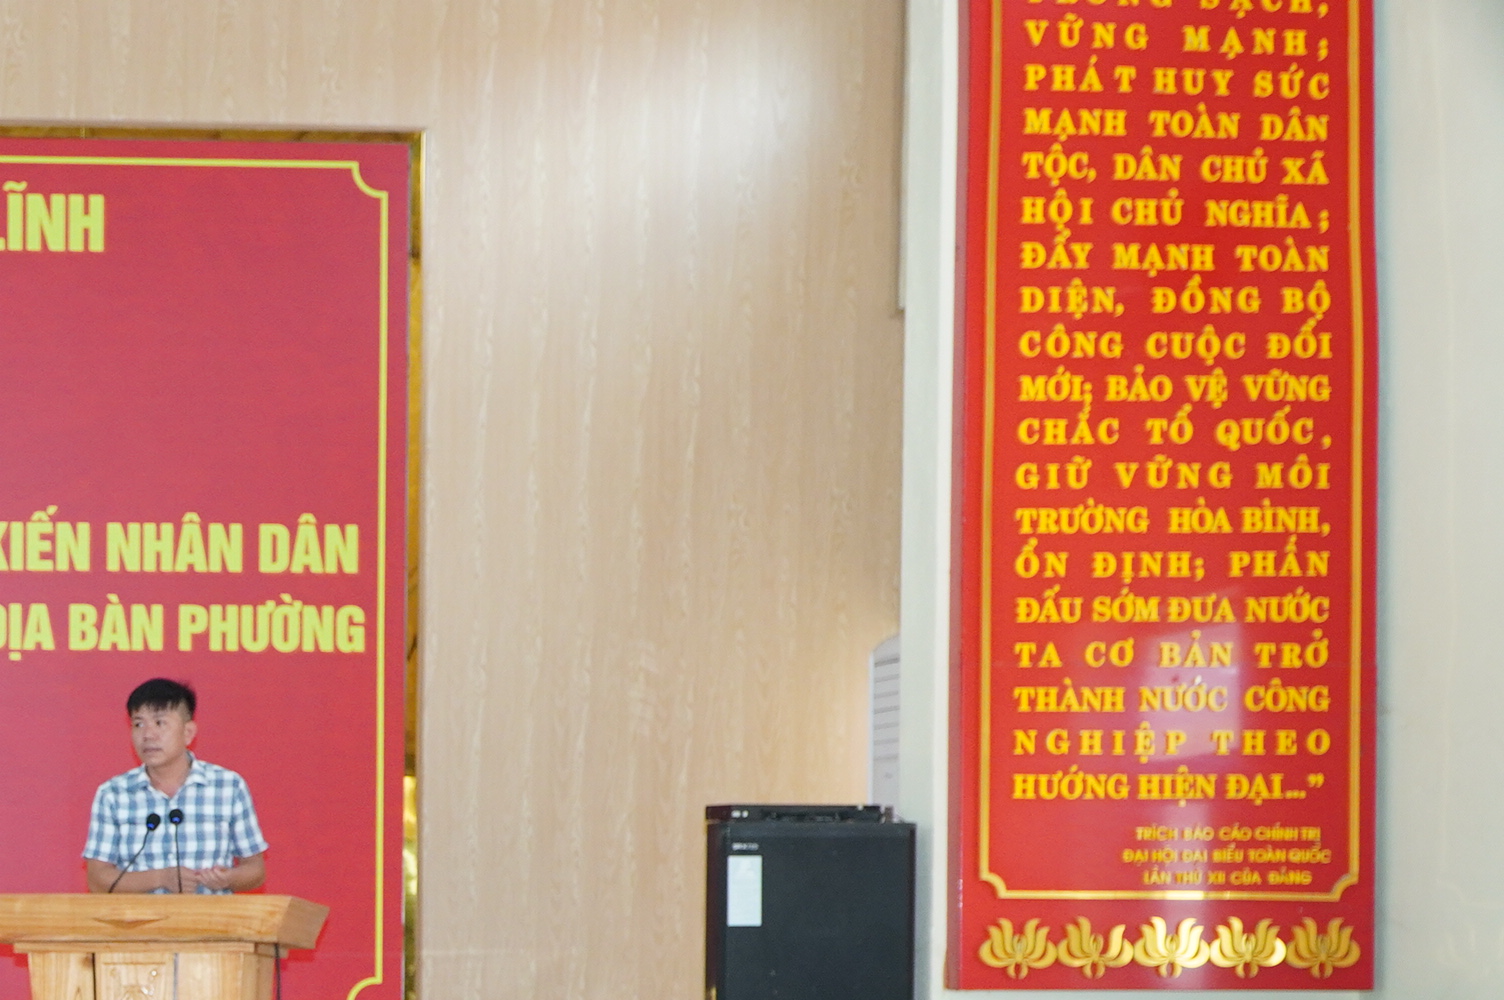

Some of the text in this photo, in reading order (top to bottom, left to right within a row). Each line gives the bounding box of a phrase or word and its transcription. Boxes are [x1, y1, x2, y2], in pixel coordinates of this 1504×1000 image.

[1025, 13, 1148, 49] VỮNG
[1025, 55, 1328, 99] PHÁT HUY SỨC
[1024, 104, 1328, 141] MẠNH TOÀN DÂN
[1022, 143, 1328, 186] TỘC, DÂN CHỦ XÃ
[1020, 188, 1093, 231] HỘI
[1112, 189, 1183, 225] CHỦ
[1113, 243, 1213, 276] MẠNH
[1236, 238, 1328, 271] TOÀN
[1021, 278, 1124, 319] DIỆN,
[1283, 280, 1330, 318] BỘ
[1019, 323, 1123, 357] CÔNG
[1146, 325, 1245, 365] CUỘC
[1106, 365, 1172, 401] BẢO
[1182, 368, 1227, 410] VỆ
[1243, 369, 1330, 401] VỮNG
[1015, 454, 1329, 489] GIỮ VỮNG MÔI
[1015, 497, 1330, 535] TRƯỜNG HÒA BÌNH,
[106, 512, 243, 573] NHÂN
[258, 513, 359, 574] DÂN
[1093, 552, 1204, 584] ĐỊNH;
[68, 593, 164, 651] BÀN
[178, 593, 365, 653] PHƯỜNG
[1016, 585, 1329, 623] ĐẤU SỚM ĐƯA NƯỚC
[1015, 629, 1329, 668] TA CƠ BẢN TRỞ
[1014, 675, 1331, 712] THÀNH NƯỚC CÔNG
[1013, 721, 1331, 764] NGHIỆP THEO
[1013, 764, 1130, 800] HƯỚNG
[1138, 765, 1217, 807] HIỆN
